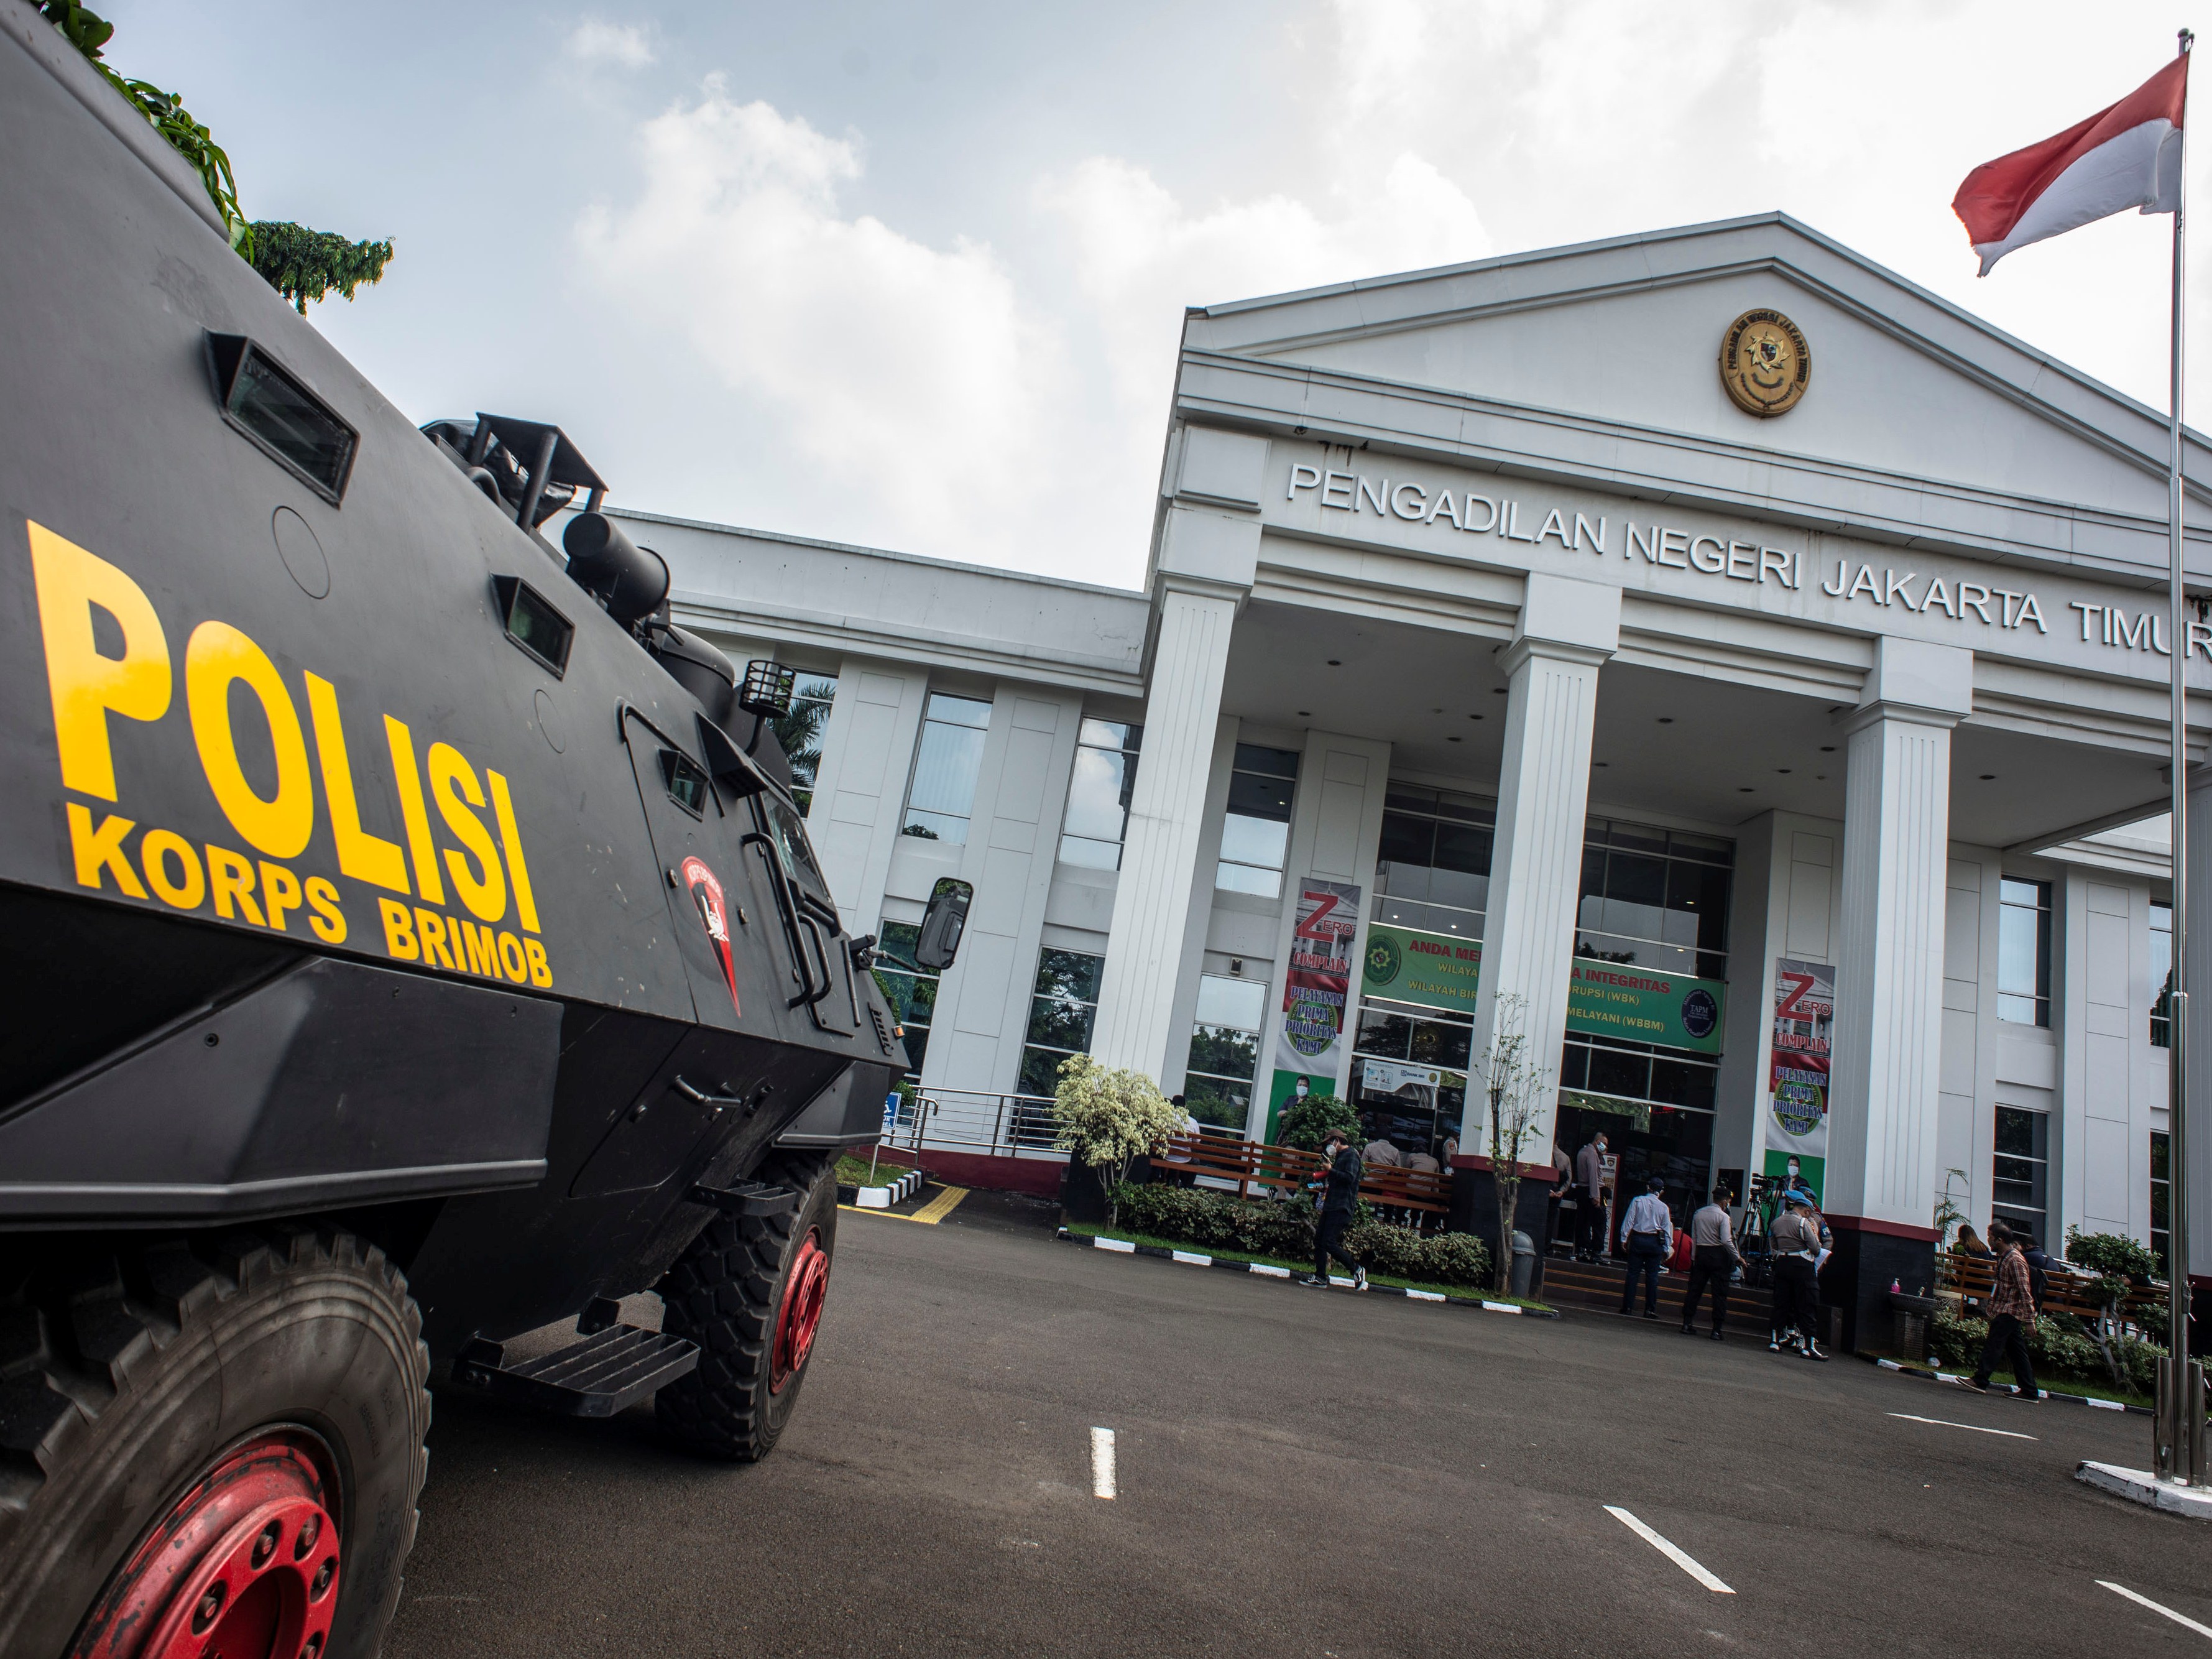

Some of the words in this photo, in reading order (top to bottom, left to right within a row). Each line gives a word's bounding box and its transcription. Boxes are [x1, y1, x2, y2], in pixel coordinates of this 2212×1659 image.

[1287, 463, 1607, 554] PENGADILAN
[1624, 522, 1802, 590] NEGERI
[1822, 560, 2048, 634] JAKARTA
[27, 519, 541, 933] POLISI
[67, 801, 347, 944] KORPS
[378, 897, 553, 988] BRIMOB
[1296, 890, 1354, 943] ZERO
[1293, 952, 1347, 973] COMPLAIN
[1409, 940, 1451, 958] ANDA
[1455, 947, 1482, 962] ME
[1586, 969, 1671, 994] INTEGRITAS
[1438, 963, 1478, 978] WILAYA
[1607, 991, 1641, 1005] (WBK)
[1290, 986, 1343, 1007] PELAYANAN
[1408, 980, 1457, 996] WILAYAH
[1460, 989, 1477, 999] BIR
[1567, 1007, 1620, 1024] MELAYANI
[1623, 1016, 1664, 1032] (WBBM)
[1777, 971, 1831, 1023] ZERO
[1297, 1004, 1329, 1022] PRIMA
[1690, 1004, 1708, 1014] TAPM
[1285, 1020, 1337, 1040] PRIORITAS
[1296, 1038, 1322, 1054] KAMI
[1776, 1033, 1827, 1053] COMPLAIN
[1775, 1066, 1827, 1086] PELAYANAN
[1782, 1084, 1813, 1101] PRIMA
[1772, 1099, 1823, 1119] PRIORITAS
[1784, 1118, 1809, 1134] KAMI
